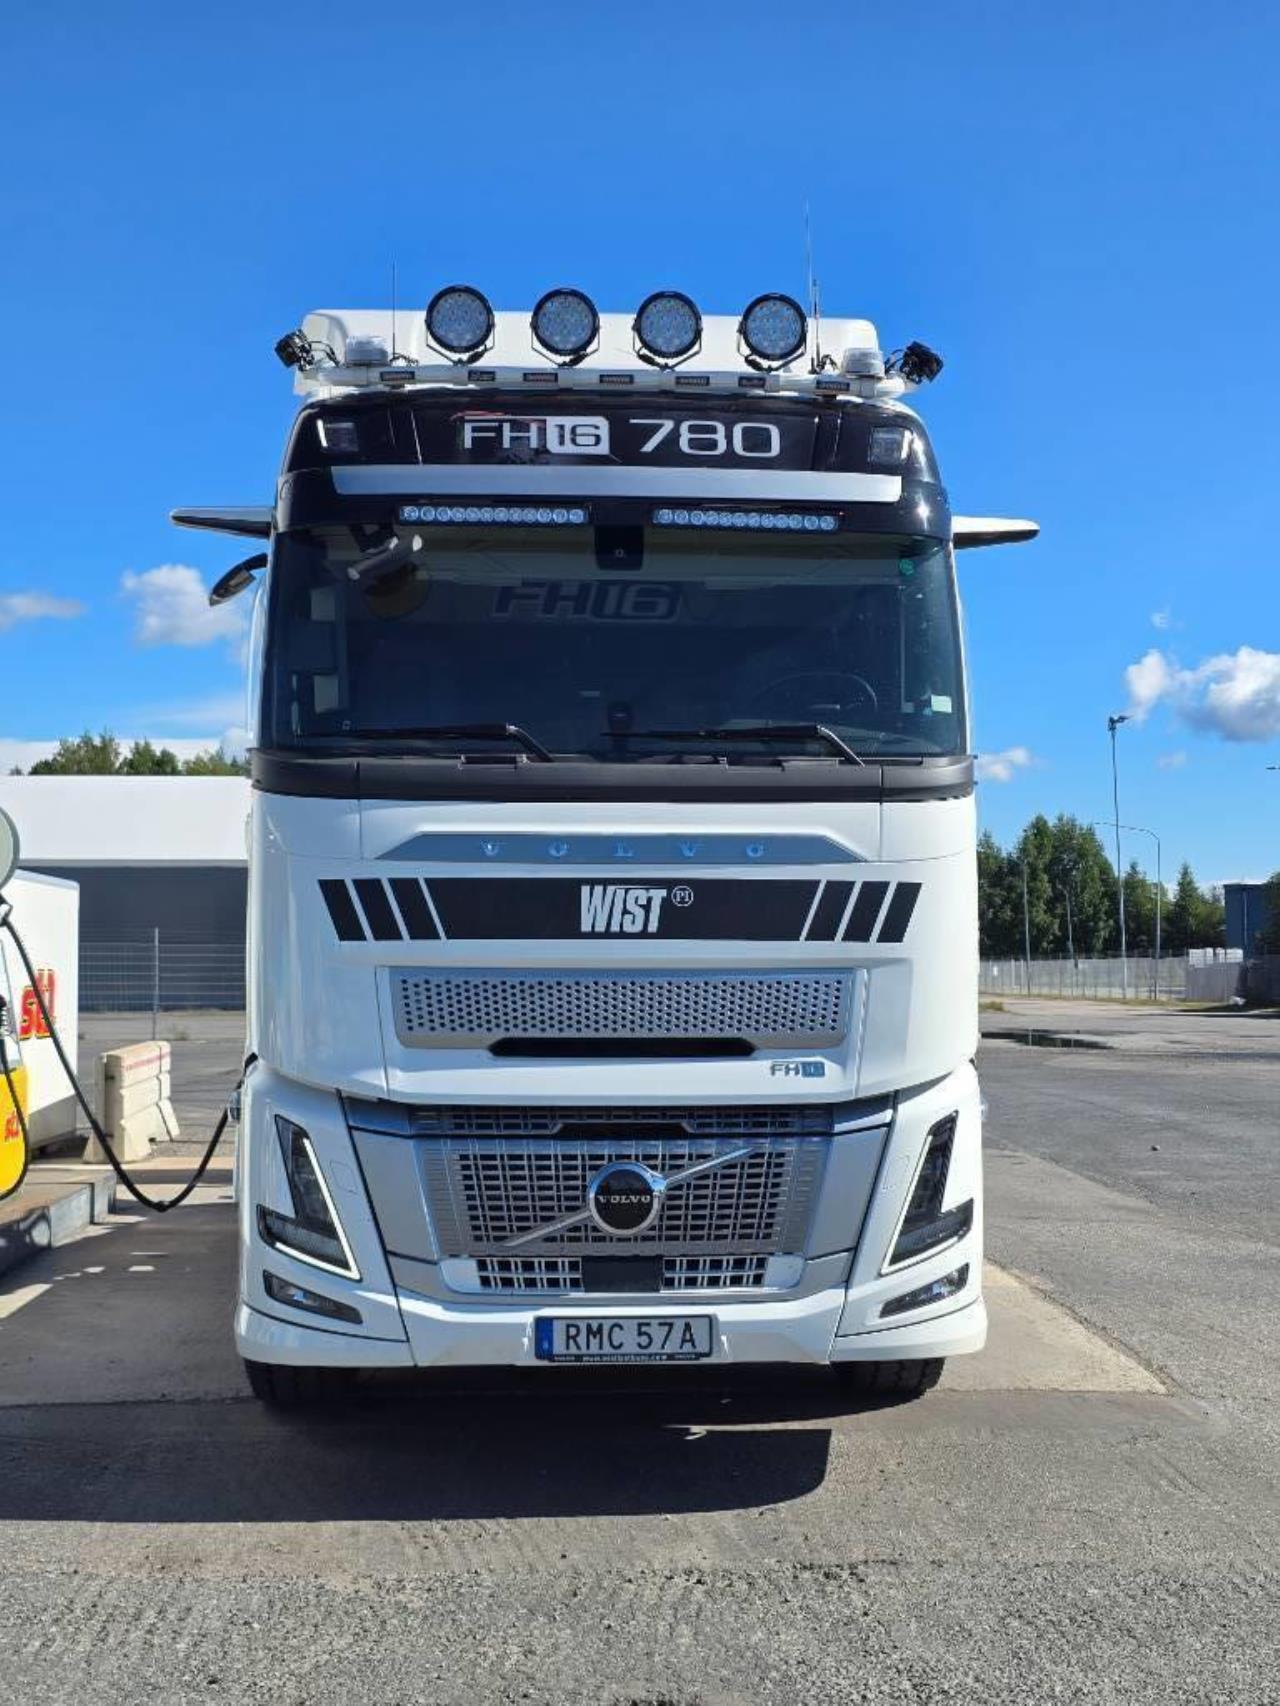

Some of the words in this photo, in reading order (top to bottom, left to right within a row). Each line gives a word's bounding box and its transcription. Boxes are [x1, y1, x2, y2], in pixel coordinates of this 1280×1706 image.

[463, 418, 605, 452] FH16
[628, 418, 781, 458] 780
[490, 581, 681, 621] FH16
[481, 841, 764, 857] VOLVO
[580, 885, 667, 933] WIST
[597, 1194, 651, 1204] VOLVO
[565, 1322, 625, 1351] RMC
[636, 1321, 697, 1350] 57A
